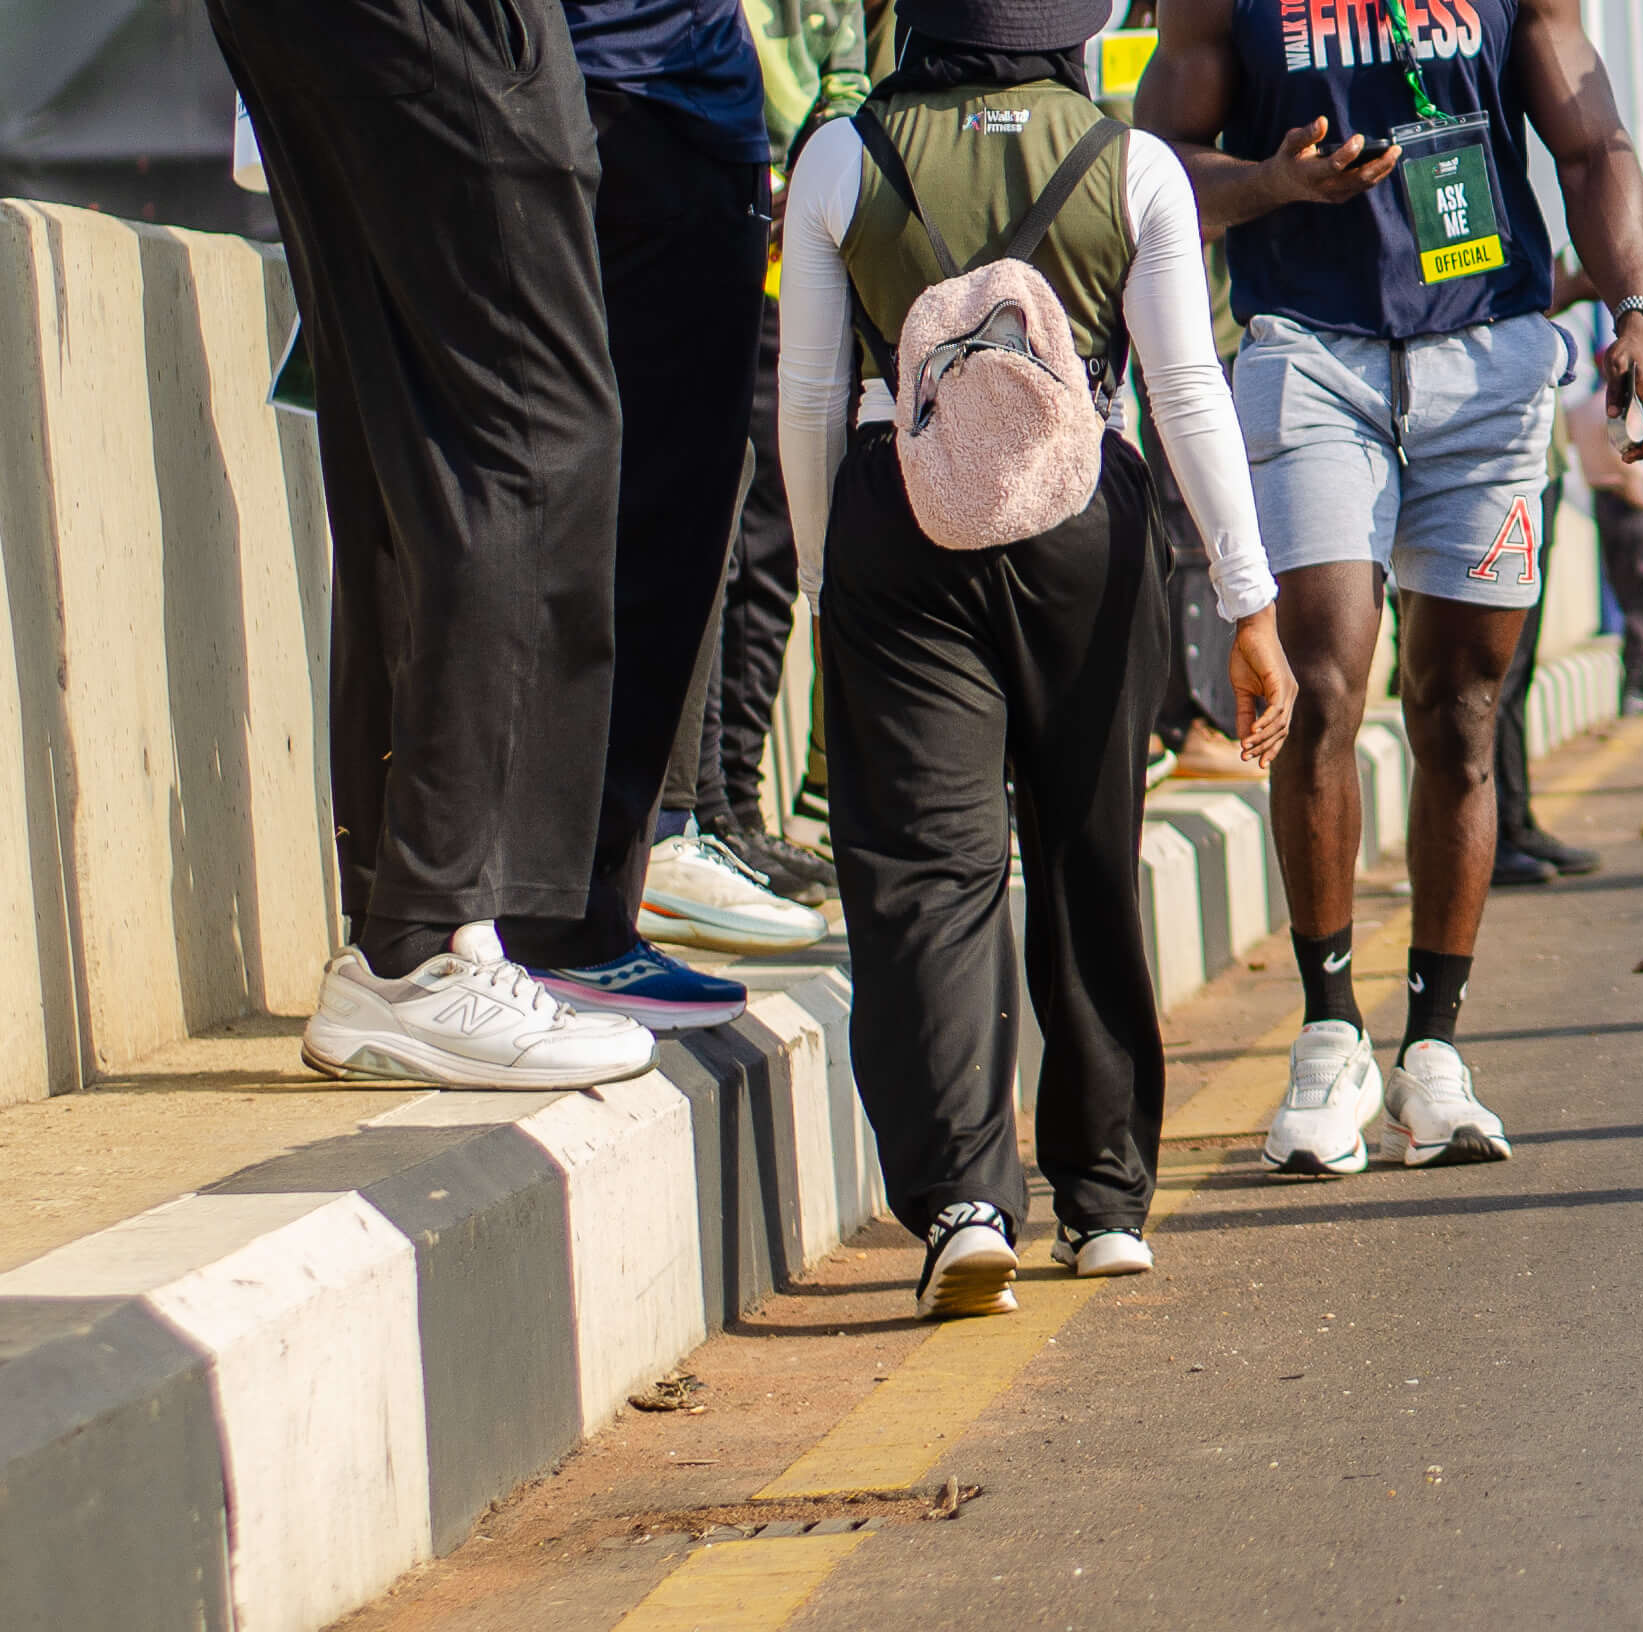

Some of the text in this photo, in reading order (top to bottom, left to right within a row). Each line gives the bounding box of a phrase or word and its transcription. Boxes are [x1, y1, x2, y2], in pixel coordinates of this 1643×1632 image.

[1281, 18, 1312, 73] WALK
[1436, 183, 1468, 214] ASK
[1443, 209, 1471, 239] ME
[1434, 244, 1491, 274] OFFICIAL
[1466, 494, 1535, 584] A
